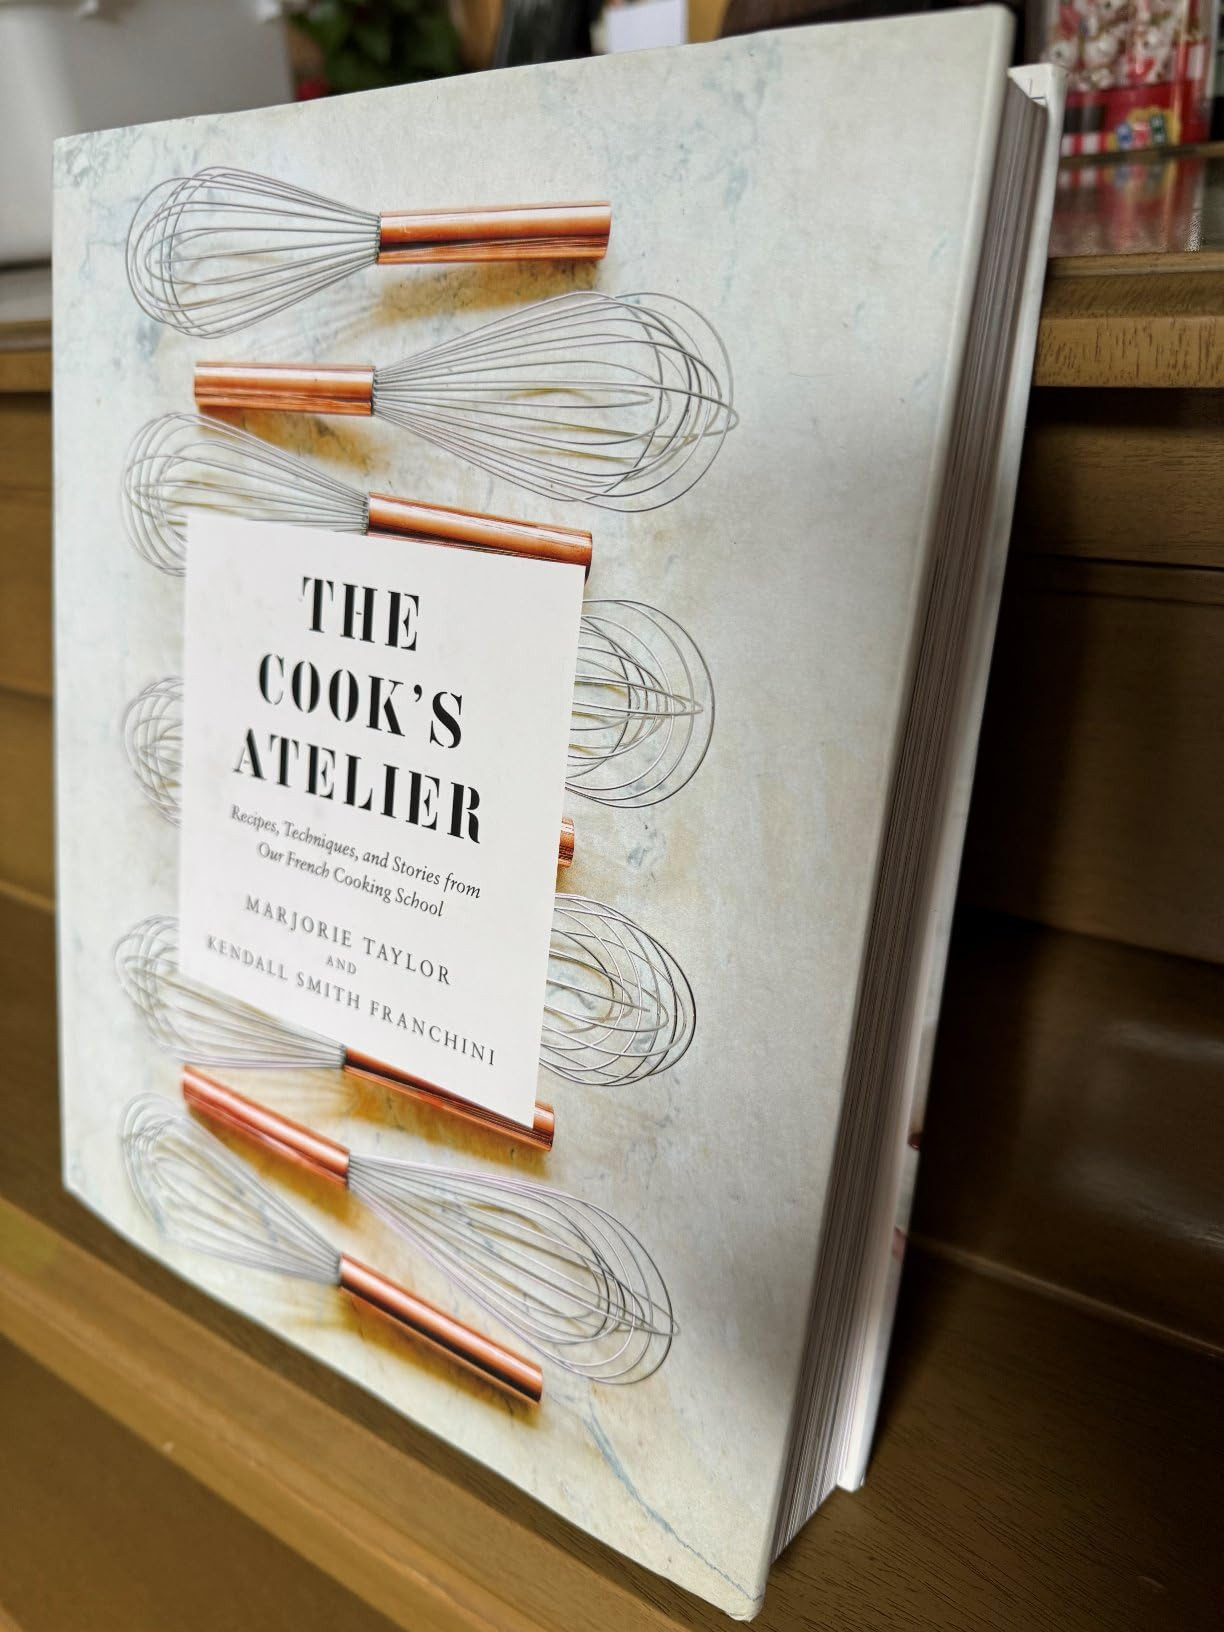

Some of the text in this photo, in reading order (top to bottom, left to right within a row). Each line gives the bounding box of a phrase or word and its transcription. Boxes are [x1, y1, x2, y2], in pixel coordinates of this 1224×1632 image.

[301, 575, 421, 653] THE
[257, 652, 464, 750] COOK'S
[233, 727, 482, 845] ATELIER
[231, 803, 481, 899] Recipes, Techniques, and Stories from
[256, 841, 445, 917] Our French Cooking School
[244, 894, 451, 986] MARJORIE TAYLOR
[325, 954, 358, 976] AND
[206, 933, 497, 1067] KENDALL SMITH FRANCHINI
